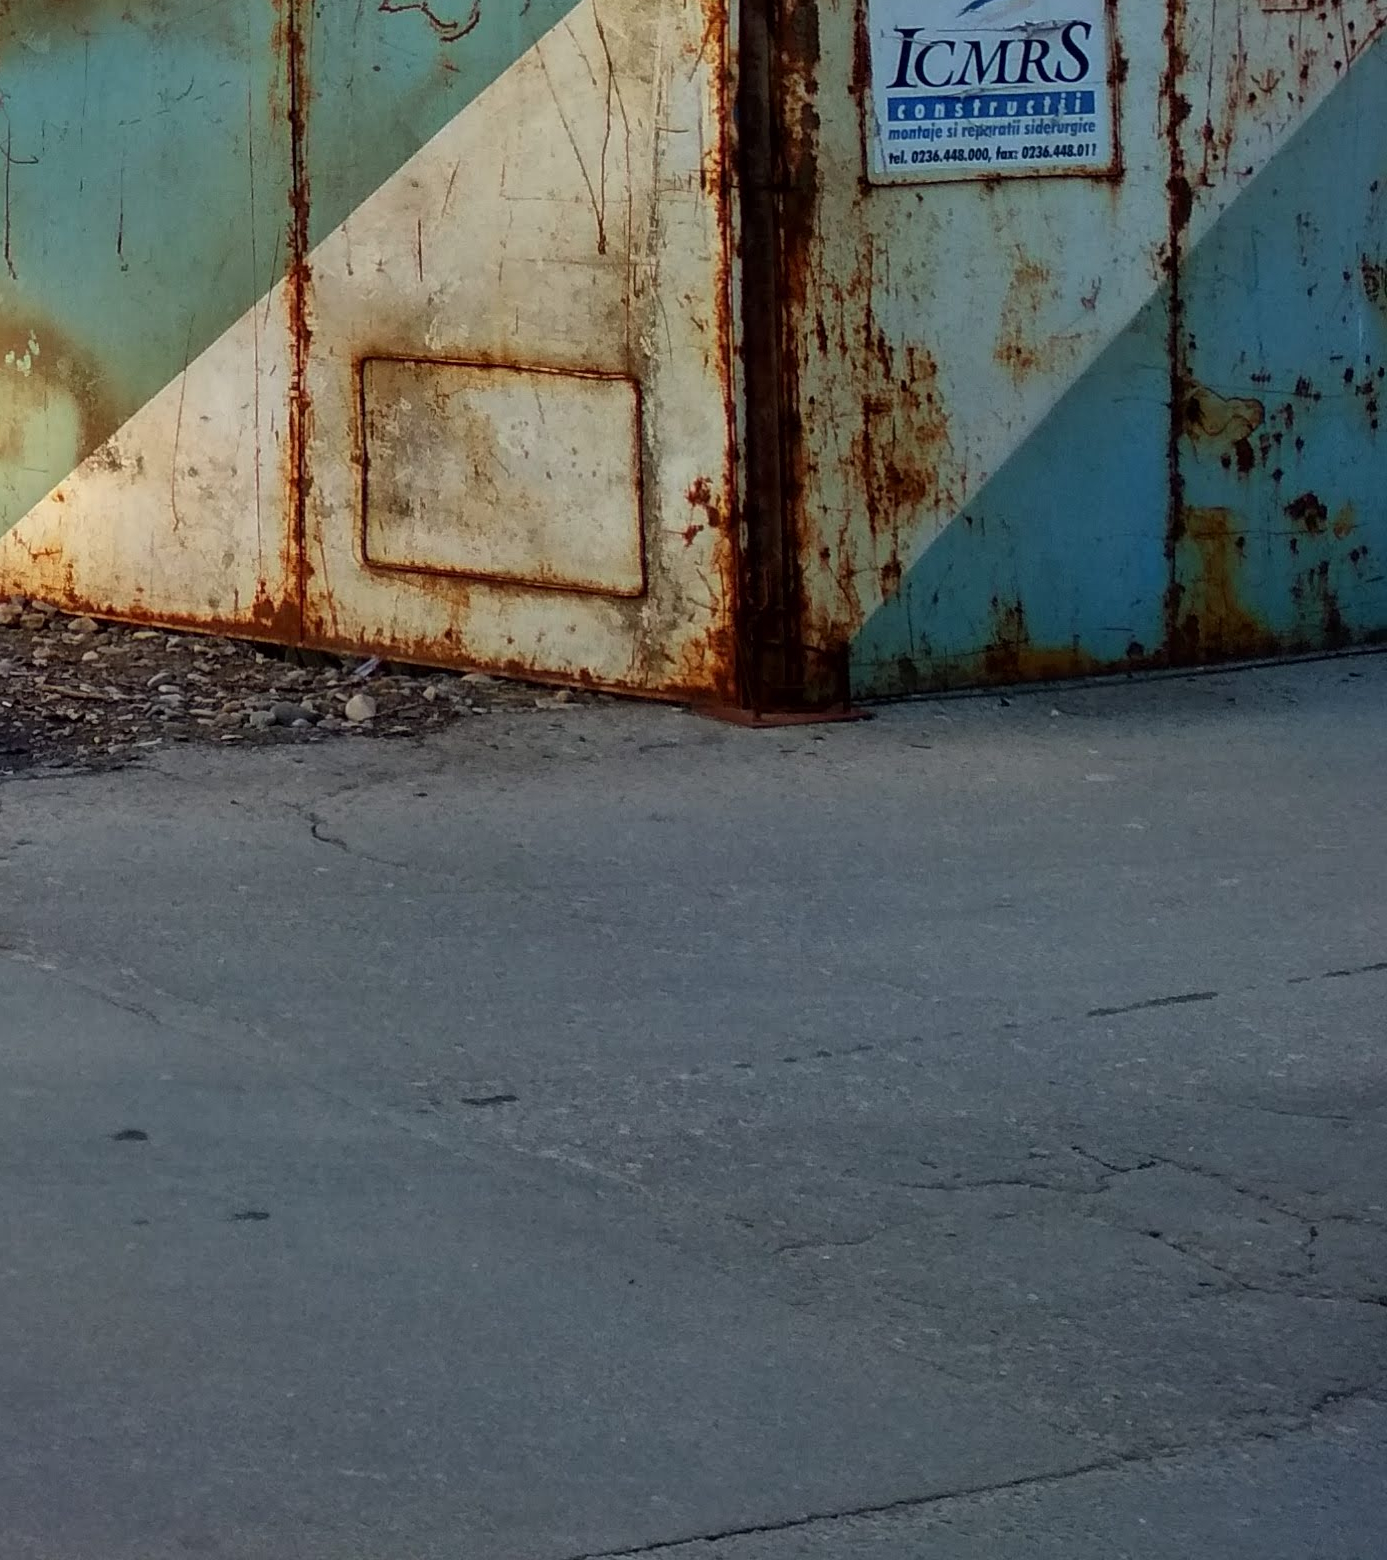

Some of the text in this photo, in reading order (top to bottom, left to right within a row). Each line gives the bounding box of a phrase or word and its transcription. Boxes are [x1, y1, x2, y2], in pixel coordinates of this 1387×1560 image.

[886, 20, 1092, 88] ICMRS
[896, 92, 1083, 119] constructii
[888, 117, 1096, 142] montaje si reparatii siderurgice
[888, 150, 908, 165] tel.
[911, 147, 992, 163] 0236.448.000,
[995, 145, 1018, 160] fax:
